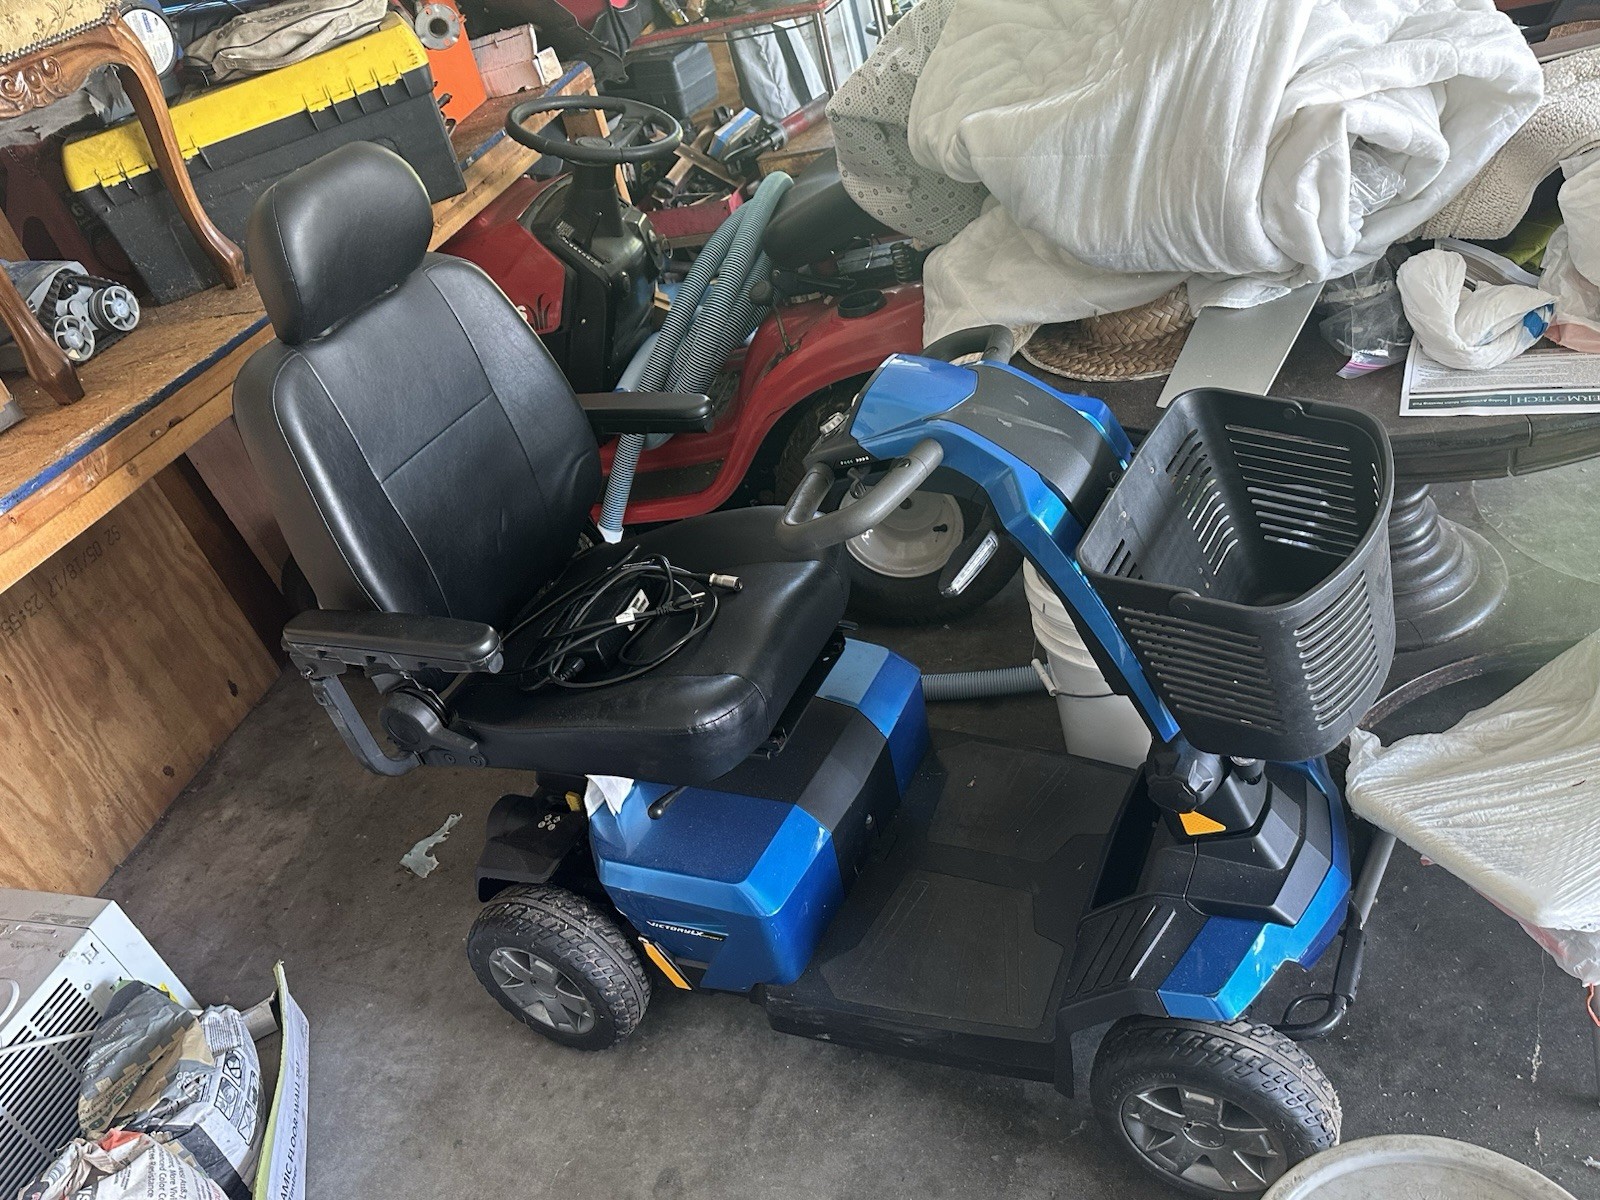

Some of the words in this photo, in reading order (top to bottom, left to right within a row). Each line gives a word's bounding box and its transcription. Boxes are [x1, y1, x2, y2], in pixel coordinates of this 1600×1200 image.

[47, 541, 103, 598] 05/18/17
[147, 1161, 157, 1198] Resistance
[158, 1172, 167, 1191] Color
